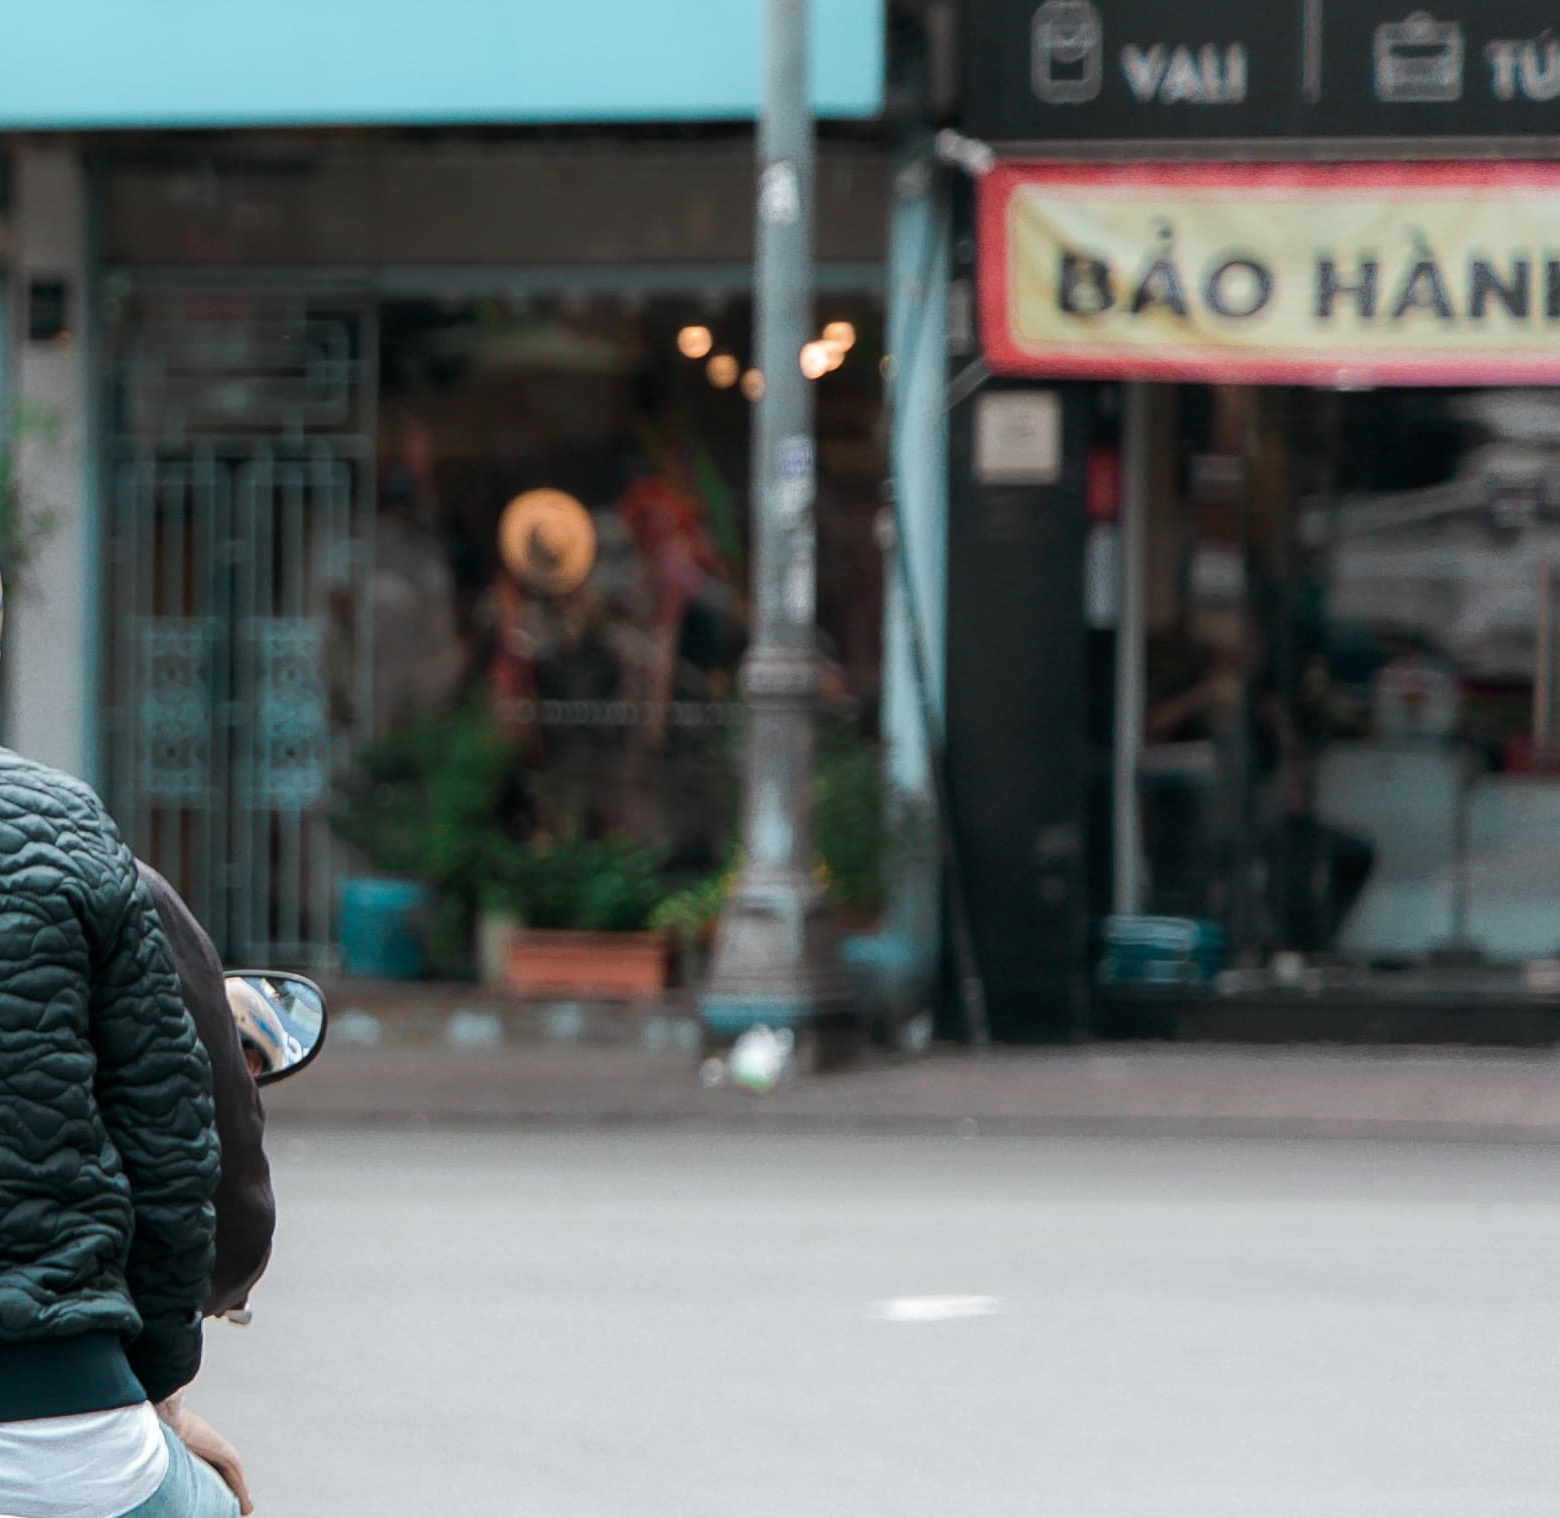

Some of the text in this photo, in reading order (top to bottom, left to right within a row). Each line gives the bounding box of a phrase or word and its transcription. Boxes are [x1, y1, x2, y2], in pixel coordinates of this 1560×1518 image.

[1118, 42, 1247, 104] VALI
[1056, 218, 1560, 320] BẢO HÀN
